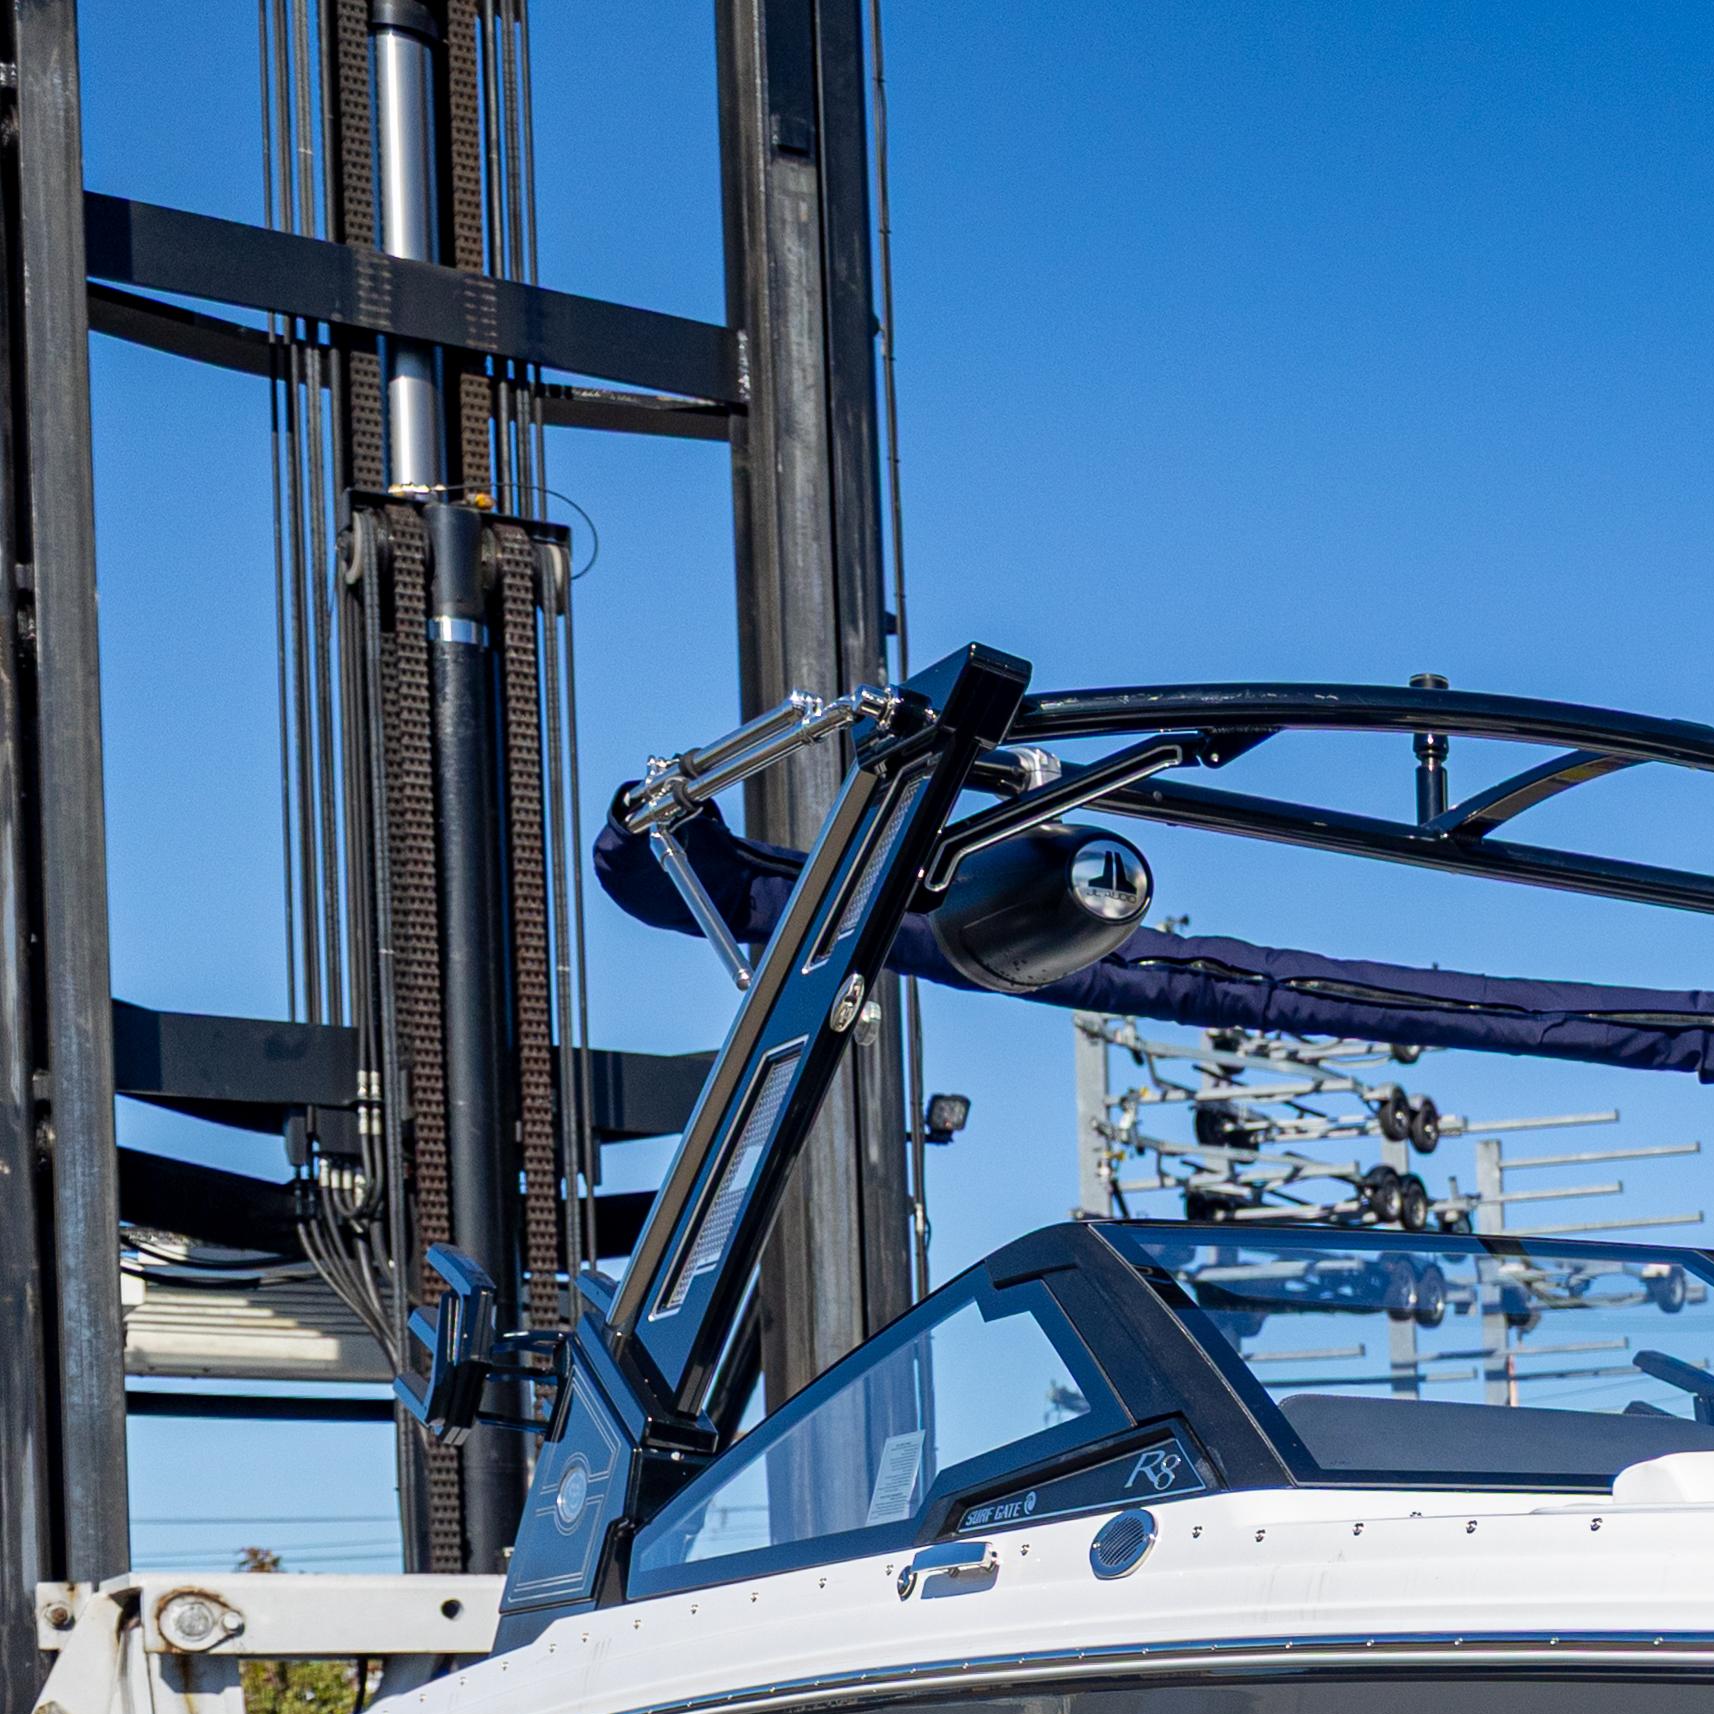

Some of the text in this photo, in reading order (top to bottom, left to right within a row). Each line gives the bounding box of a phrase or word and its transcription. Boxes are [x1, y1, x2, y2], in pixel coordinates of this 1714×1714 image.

[1124, 1449, 1181, 1491] R8
[964, 1501, 1023, 1527] SURF GATE
